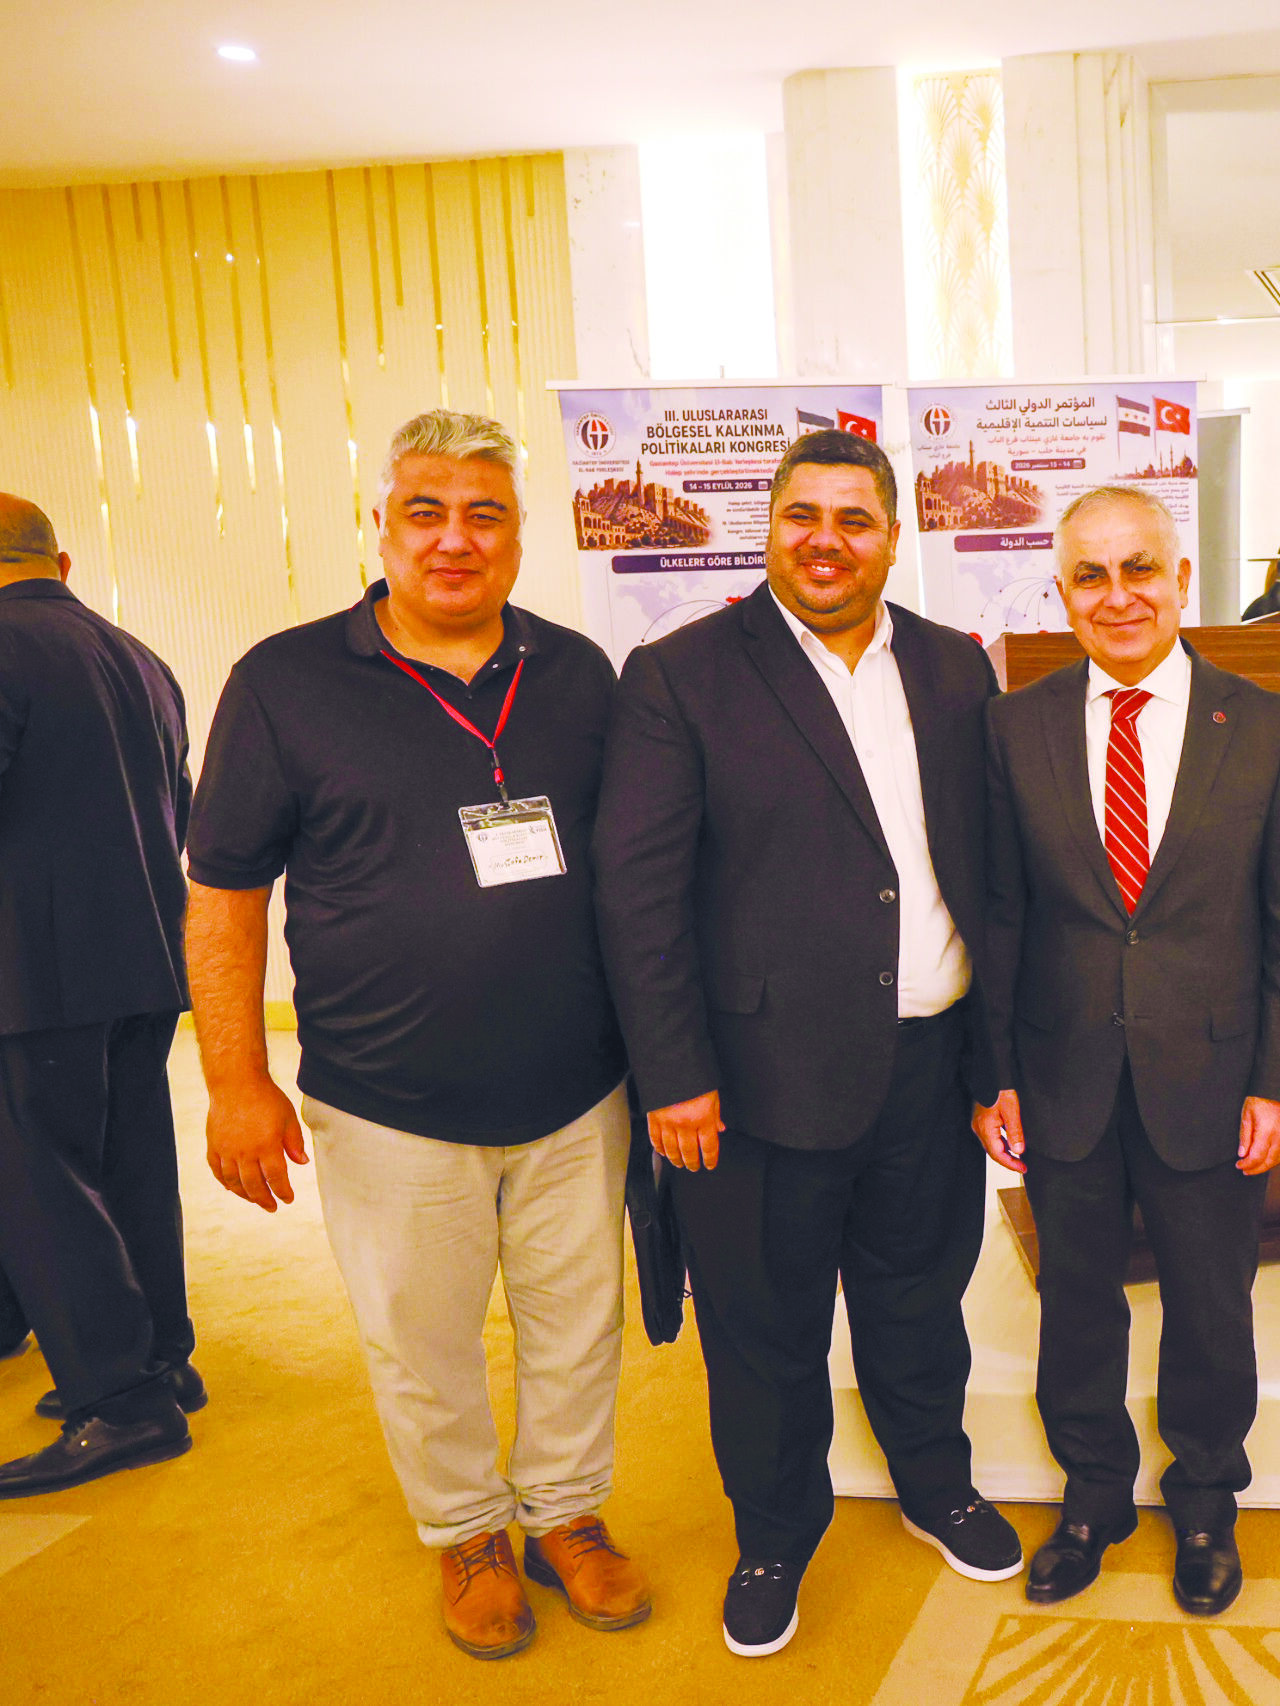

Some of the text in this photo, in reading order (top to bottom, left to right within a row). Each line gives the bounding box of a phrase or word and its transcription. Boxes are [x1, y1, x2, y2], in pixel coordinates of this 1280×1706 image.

[985, 396, 1095, 415] المؤتمر الدولي الثالث
[664, 408, 768, 422] III. ULUSLARARASI
[646, 423, 785, 439] BÖLGESEL KALKINMA
[976, 416, 1107, 432] لسياسات التنمية الإقليمية
[641, 437, 791, 455] POLİTİKALARI KONGRESİ
[712, 481, 734, 489] EYLÜL
[1000, 536, 1024, 549] الدولة
[660, 556, 706, 568] ÜLKELERE
[707, 555, 732, 567] GÖRE
